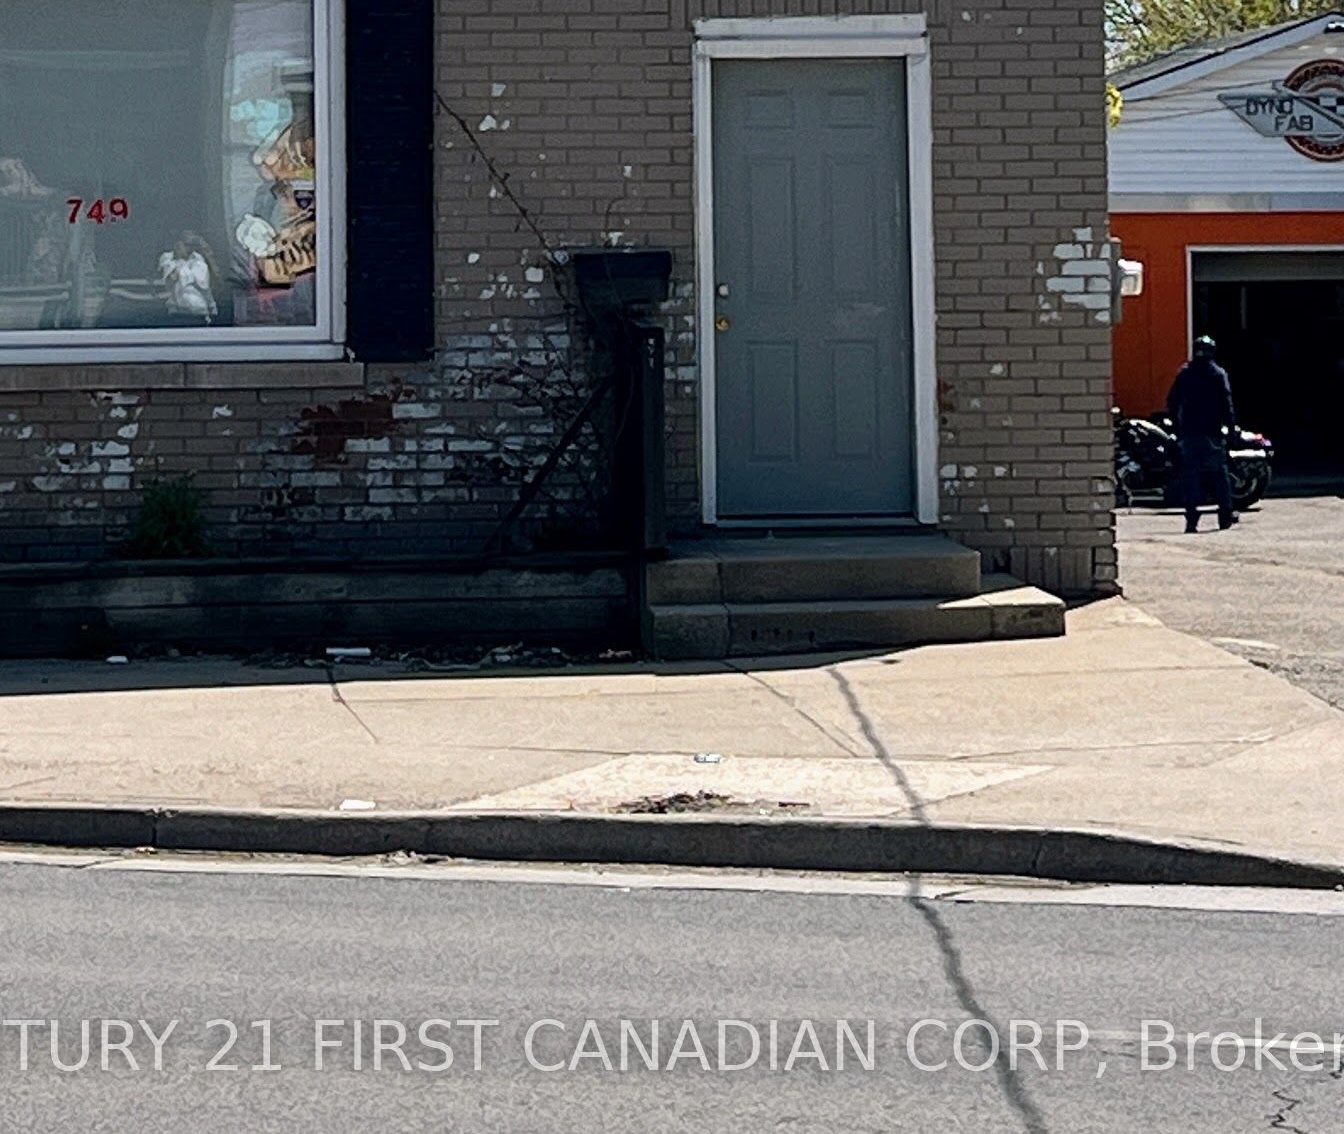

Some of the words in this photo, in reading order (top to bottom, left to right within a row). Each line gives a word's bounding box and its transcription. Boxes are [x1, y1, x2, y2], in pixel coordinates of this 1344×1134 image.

[1246, 97, 1293, 116] DYNO
[1275, 115, 1313, 132] FAB
[66, 199, 128, 224] 749
